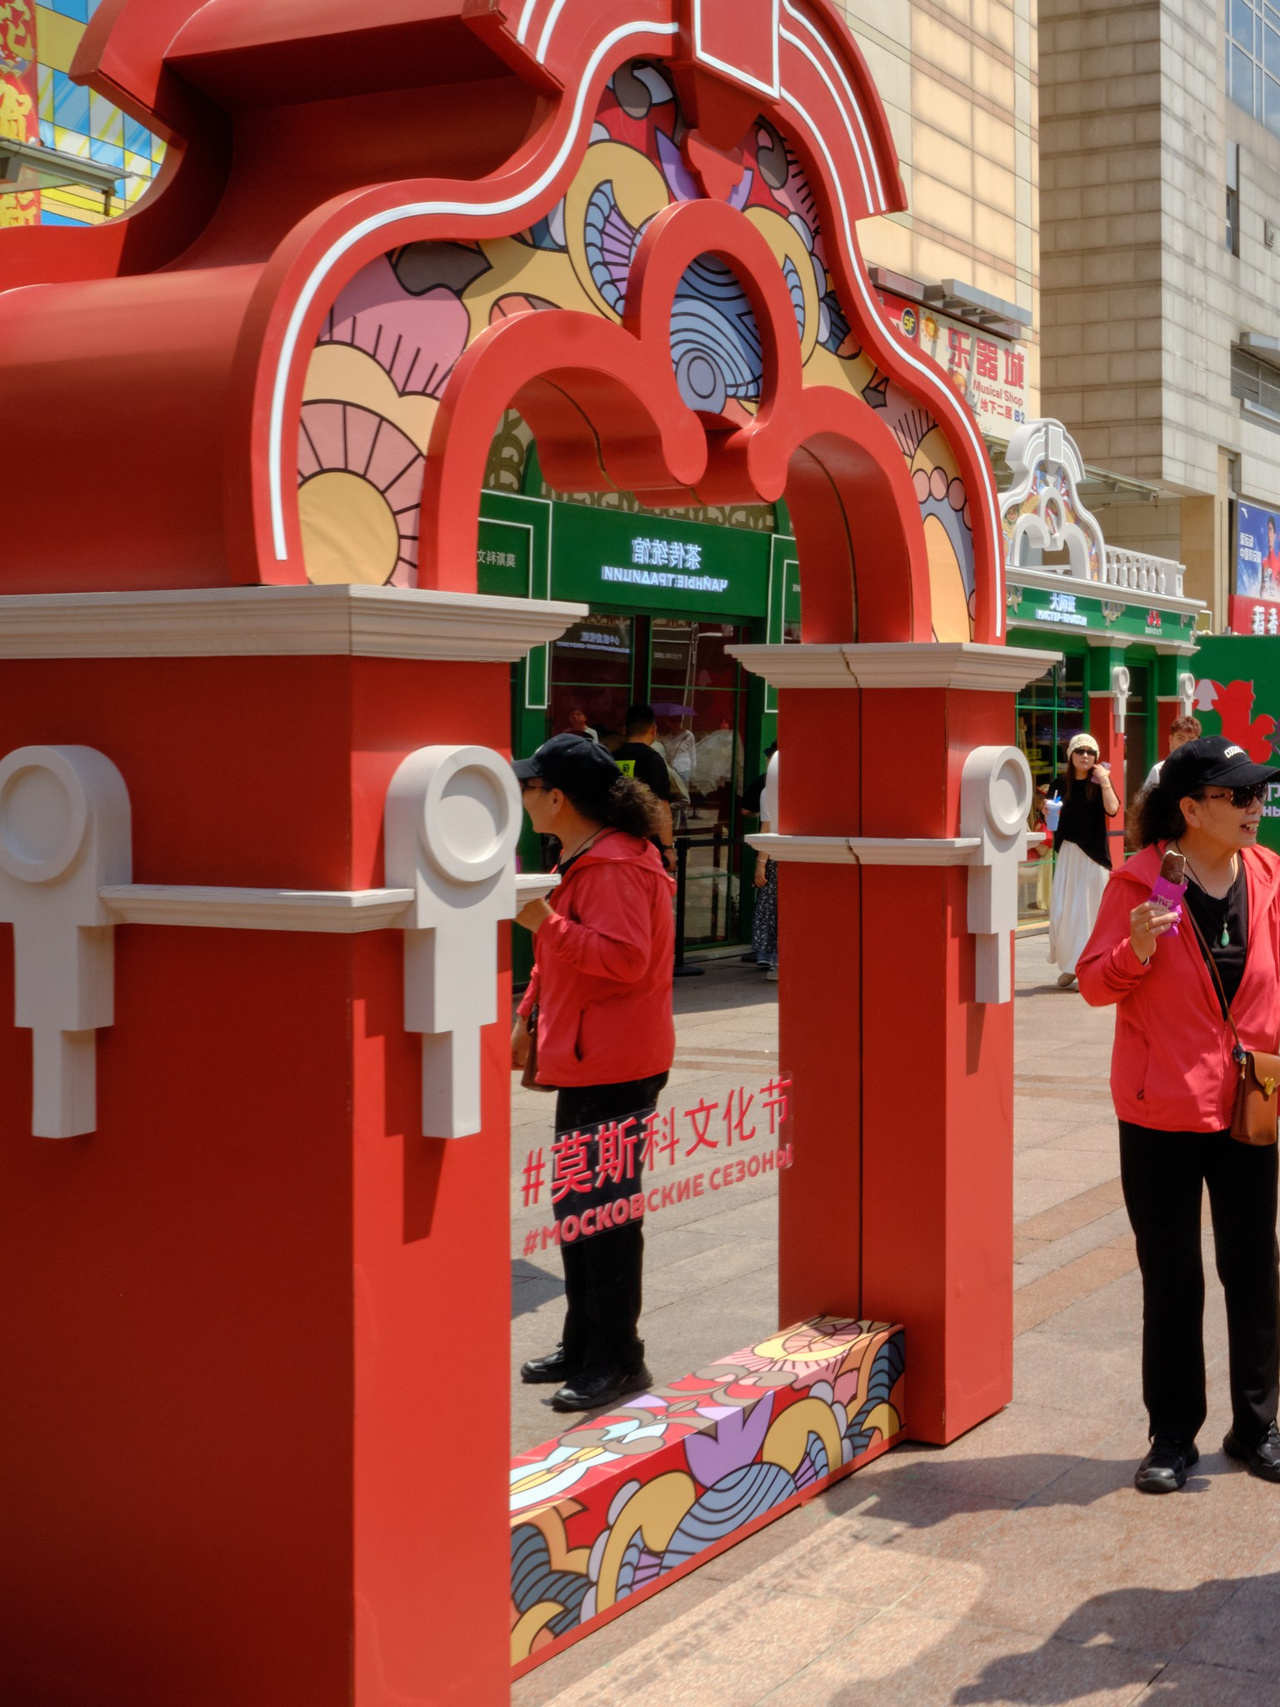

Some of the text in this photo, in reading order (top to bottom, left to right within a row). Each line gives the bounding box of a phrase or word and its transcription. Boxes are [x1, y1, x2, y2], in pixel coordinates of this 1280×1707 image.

[903, 315, 915, 331] 5F
[947, 326, 1025, 390] 乐器城
[973, 379, 1024, 407] Musical Shop
[980, 398, 1025, 424] 地下二层 B2
[520, 1076, 793, 1207] #莫斯科文化节
[523, 1143, 793, 1257] #МОСКОВСКИЕ СЕЗОНЫ
